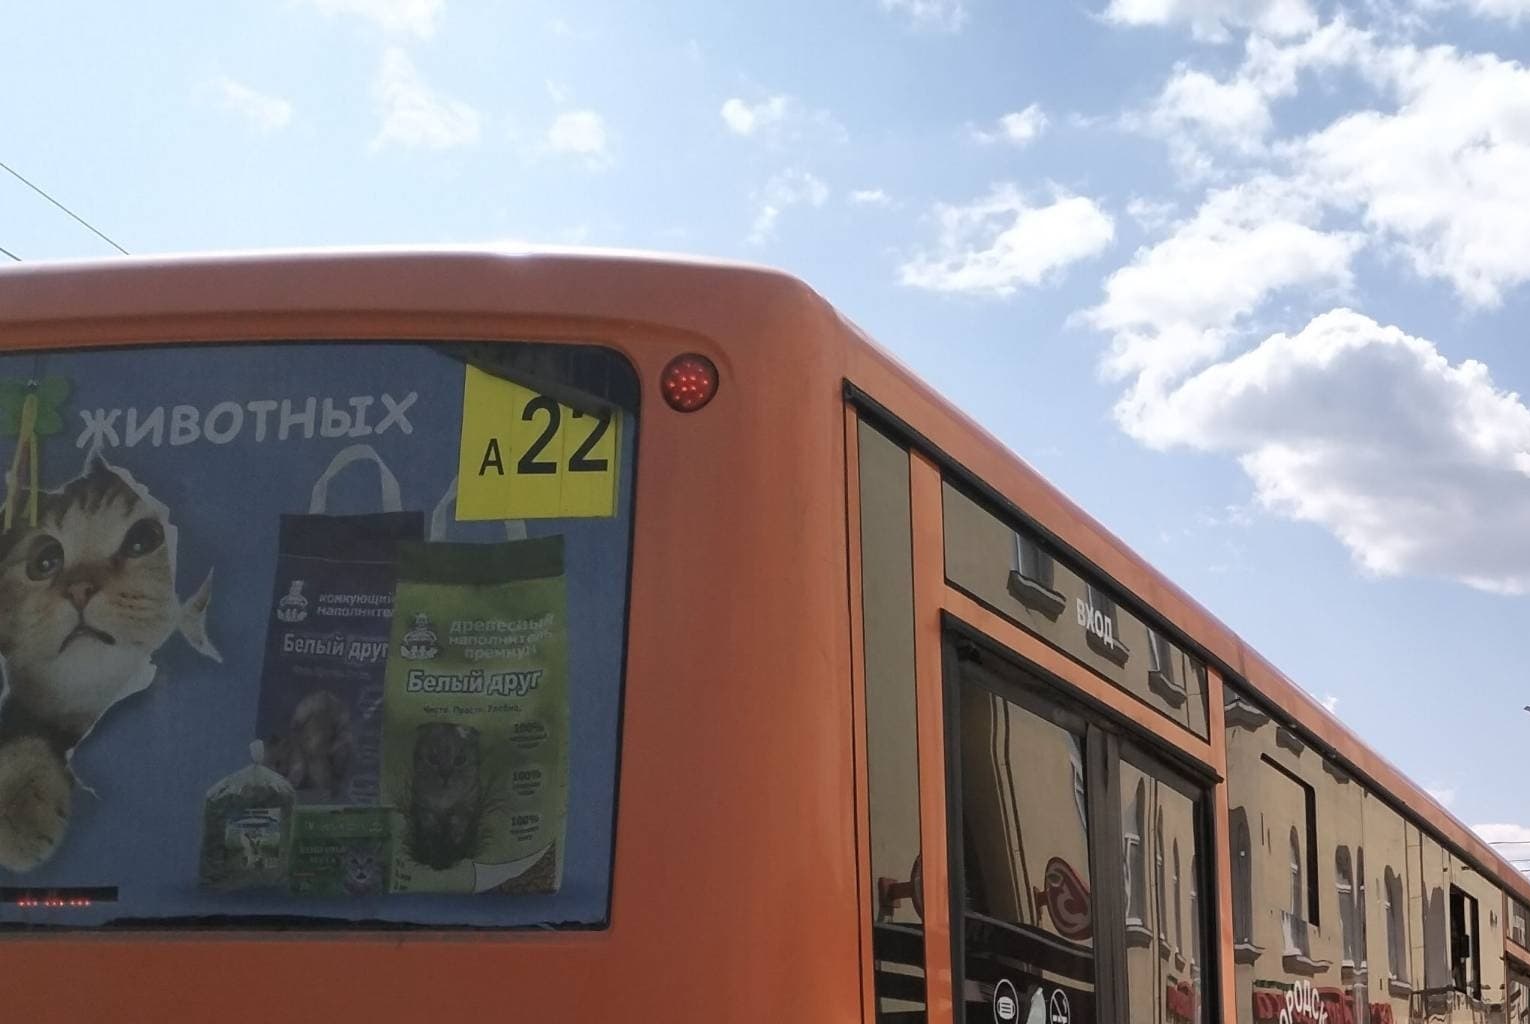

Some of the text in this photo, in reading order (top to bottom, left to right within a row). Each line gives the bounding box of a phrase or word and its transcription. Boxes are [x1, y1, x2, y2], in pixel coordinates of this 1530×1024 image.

[74, 391, 415, 449] ЖИВОТНЫХ
[1076, 597, 1115, 650] ВХОД
[282, 632, 344, 660] Белый
[406, 669, 545, 697] Белый друг
